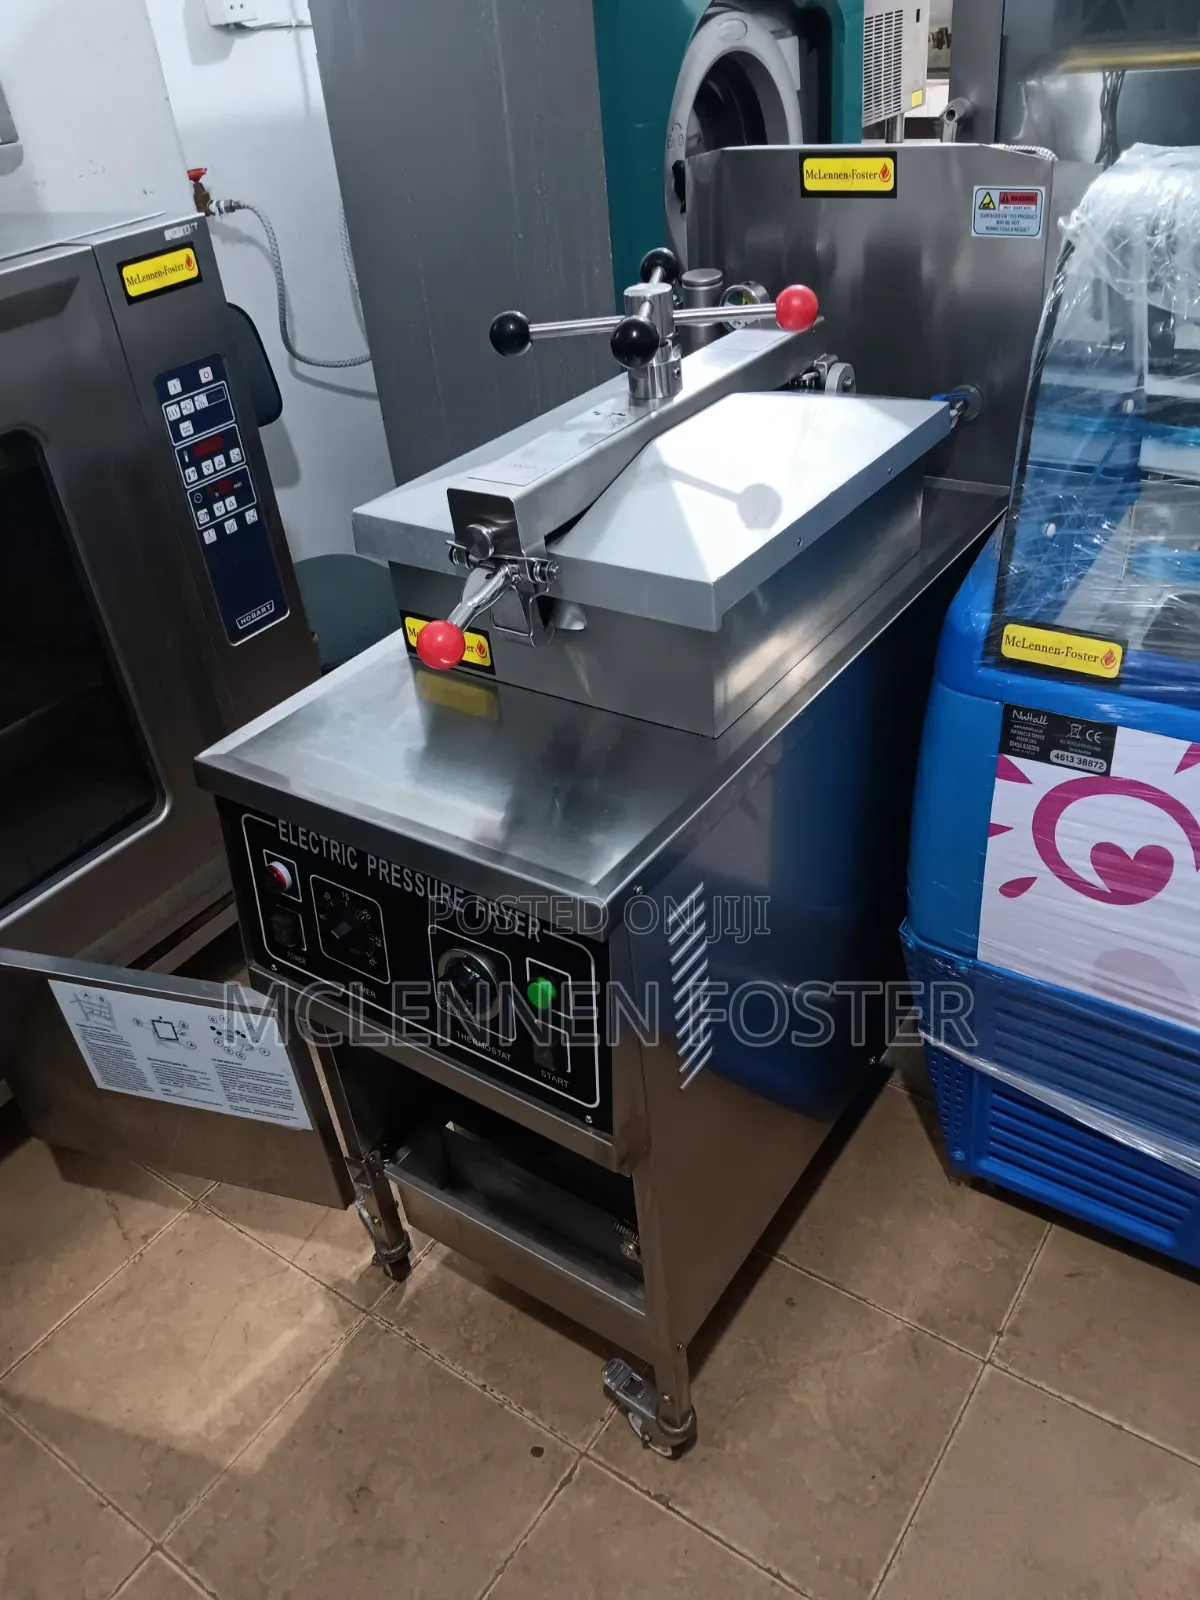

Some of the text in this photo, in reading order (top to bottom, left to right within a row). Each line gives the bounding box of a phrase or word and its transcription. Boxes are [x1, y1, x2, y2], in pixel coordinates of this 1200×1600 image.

[805, 168, 878, 181] McLennen-Foster
[126, 264, 184, 287] McLennen-Foster
[240, 603, 271, 625] HOBART
[1004, 634, 1100, 663] McLennen-Foster
[1012, 709, 1049, 725] Nuttall
[1054, 752, 1104, 770] 4513 38872
[278, 818, 358, 870] ELECTRIC
[367, 853, 464, 913] PRESSURE
[354, 982, 376, 999] TIMER
[456, 1030, 512, 1061] THERMOSTAT
[540, 1069, 570, 1088] START
